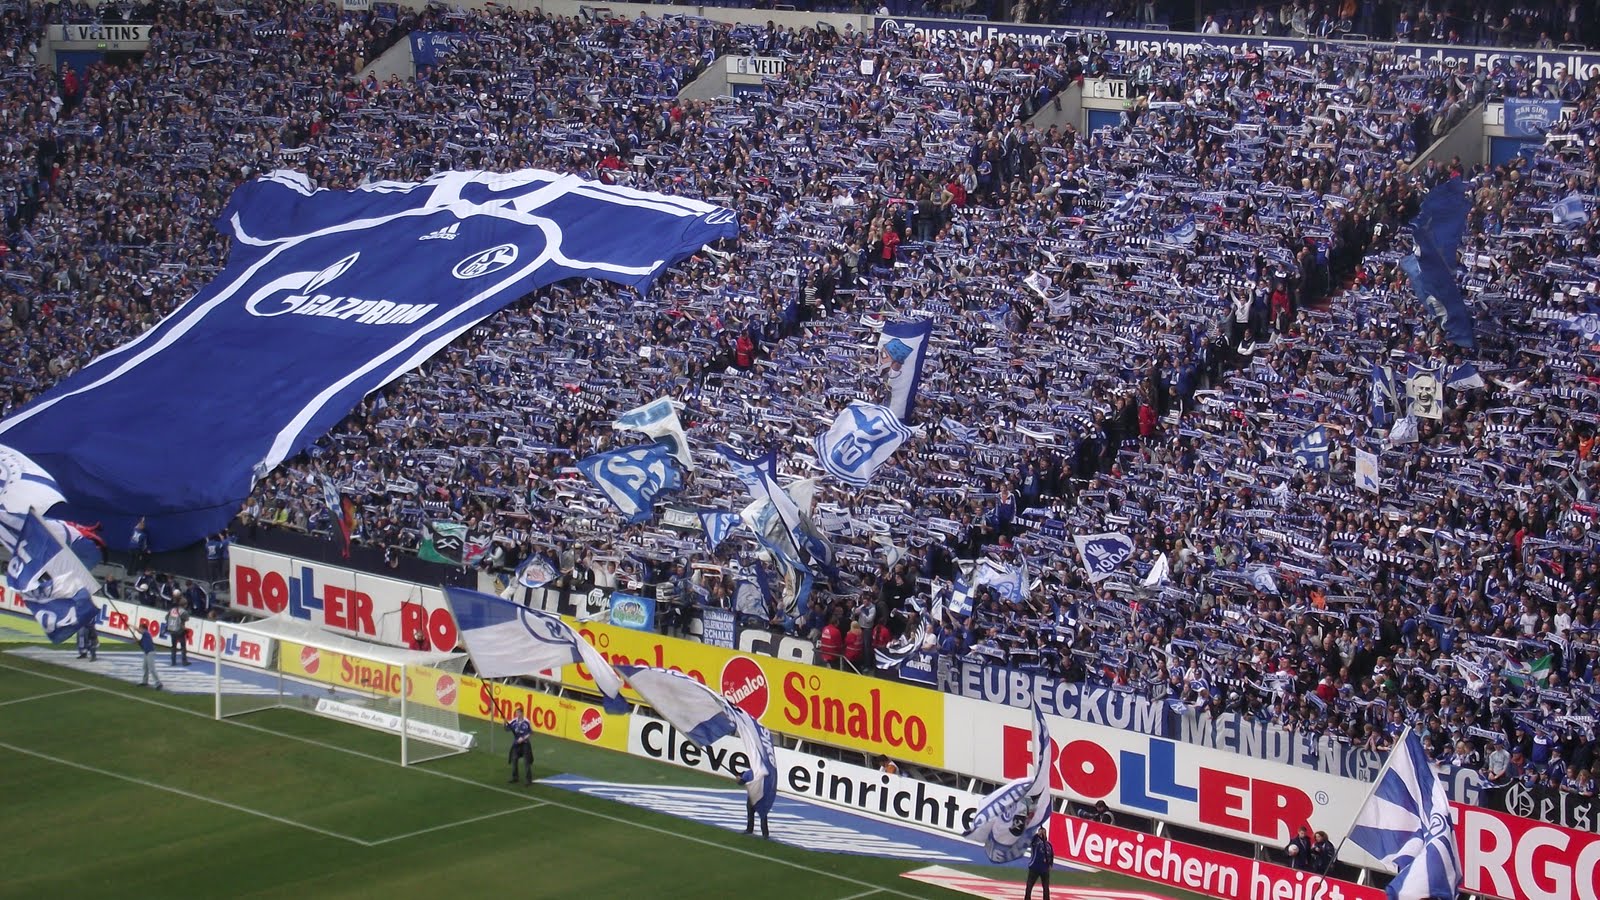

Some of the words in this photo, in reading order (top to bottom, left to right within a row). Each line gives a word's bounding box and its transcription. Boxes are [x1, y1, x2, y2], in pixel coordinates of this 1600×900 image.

[904, 22, 982, 47] Tausnd
[292, 294, 440, 325] GAZPROM
[1095, 547, 1130, 573] 1904
[236, 565, 376, 636] ROLLER
[139, 617, 194, 646] ROLR
[203, 633, 261, 662] ROLLER
[704, 629, 734, 640] SCHALKE
[341, 655, 413, 698] Sinalco
[724, 674, 766, 707] Sinalco
[783, 671, 927, 753] Sinalco
[641, 721, 752, 776] Cleve
[1181, 706, 1342, 777] MENDEN
[1003, 725, 1314, 848] ROLLER
[1505, 782, 1600, 833] Gels
[1065, 818, 1239, 897] Versichern
